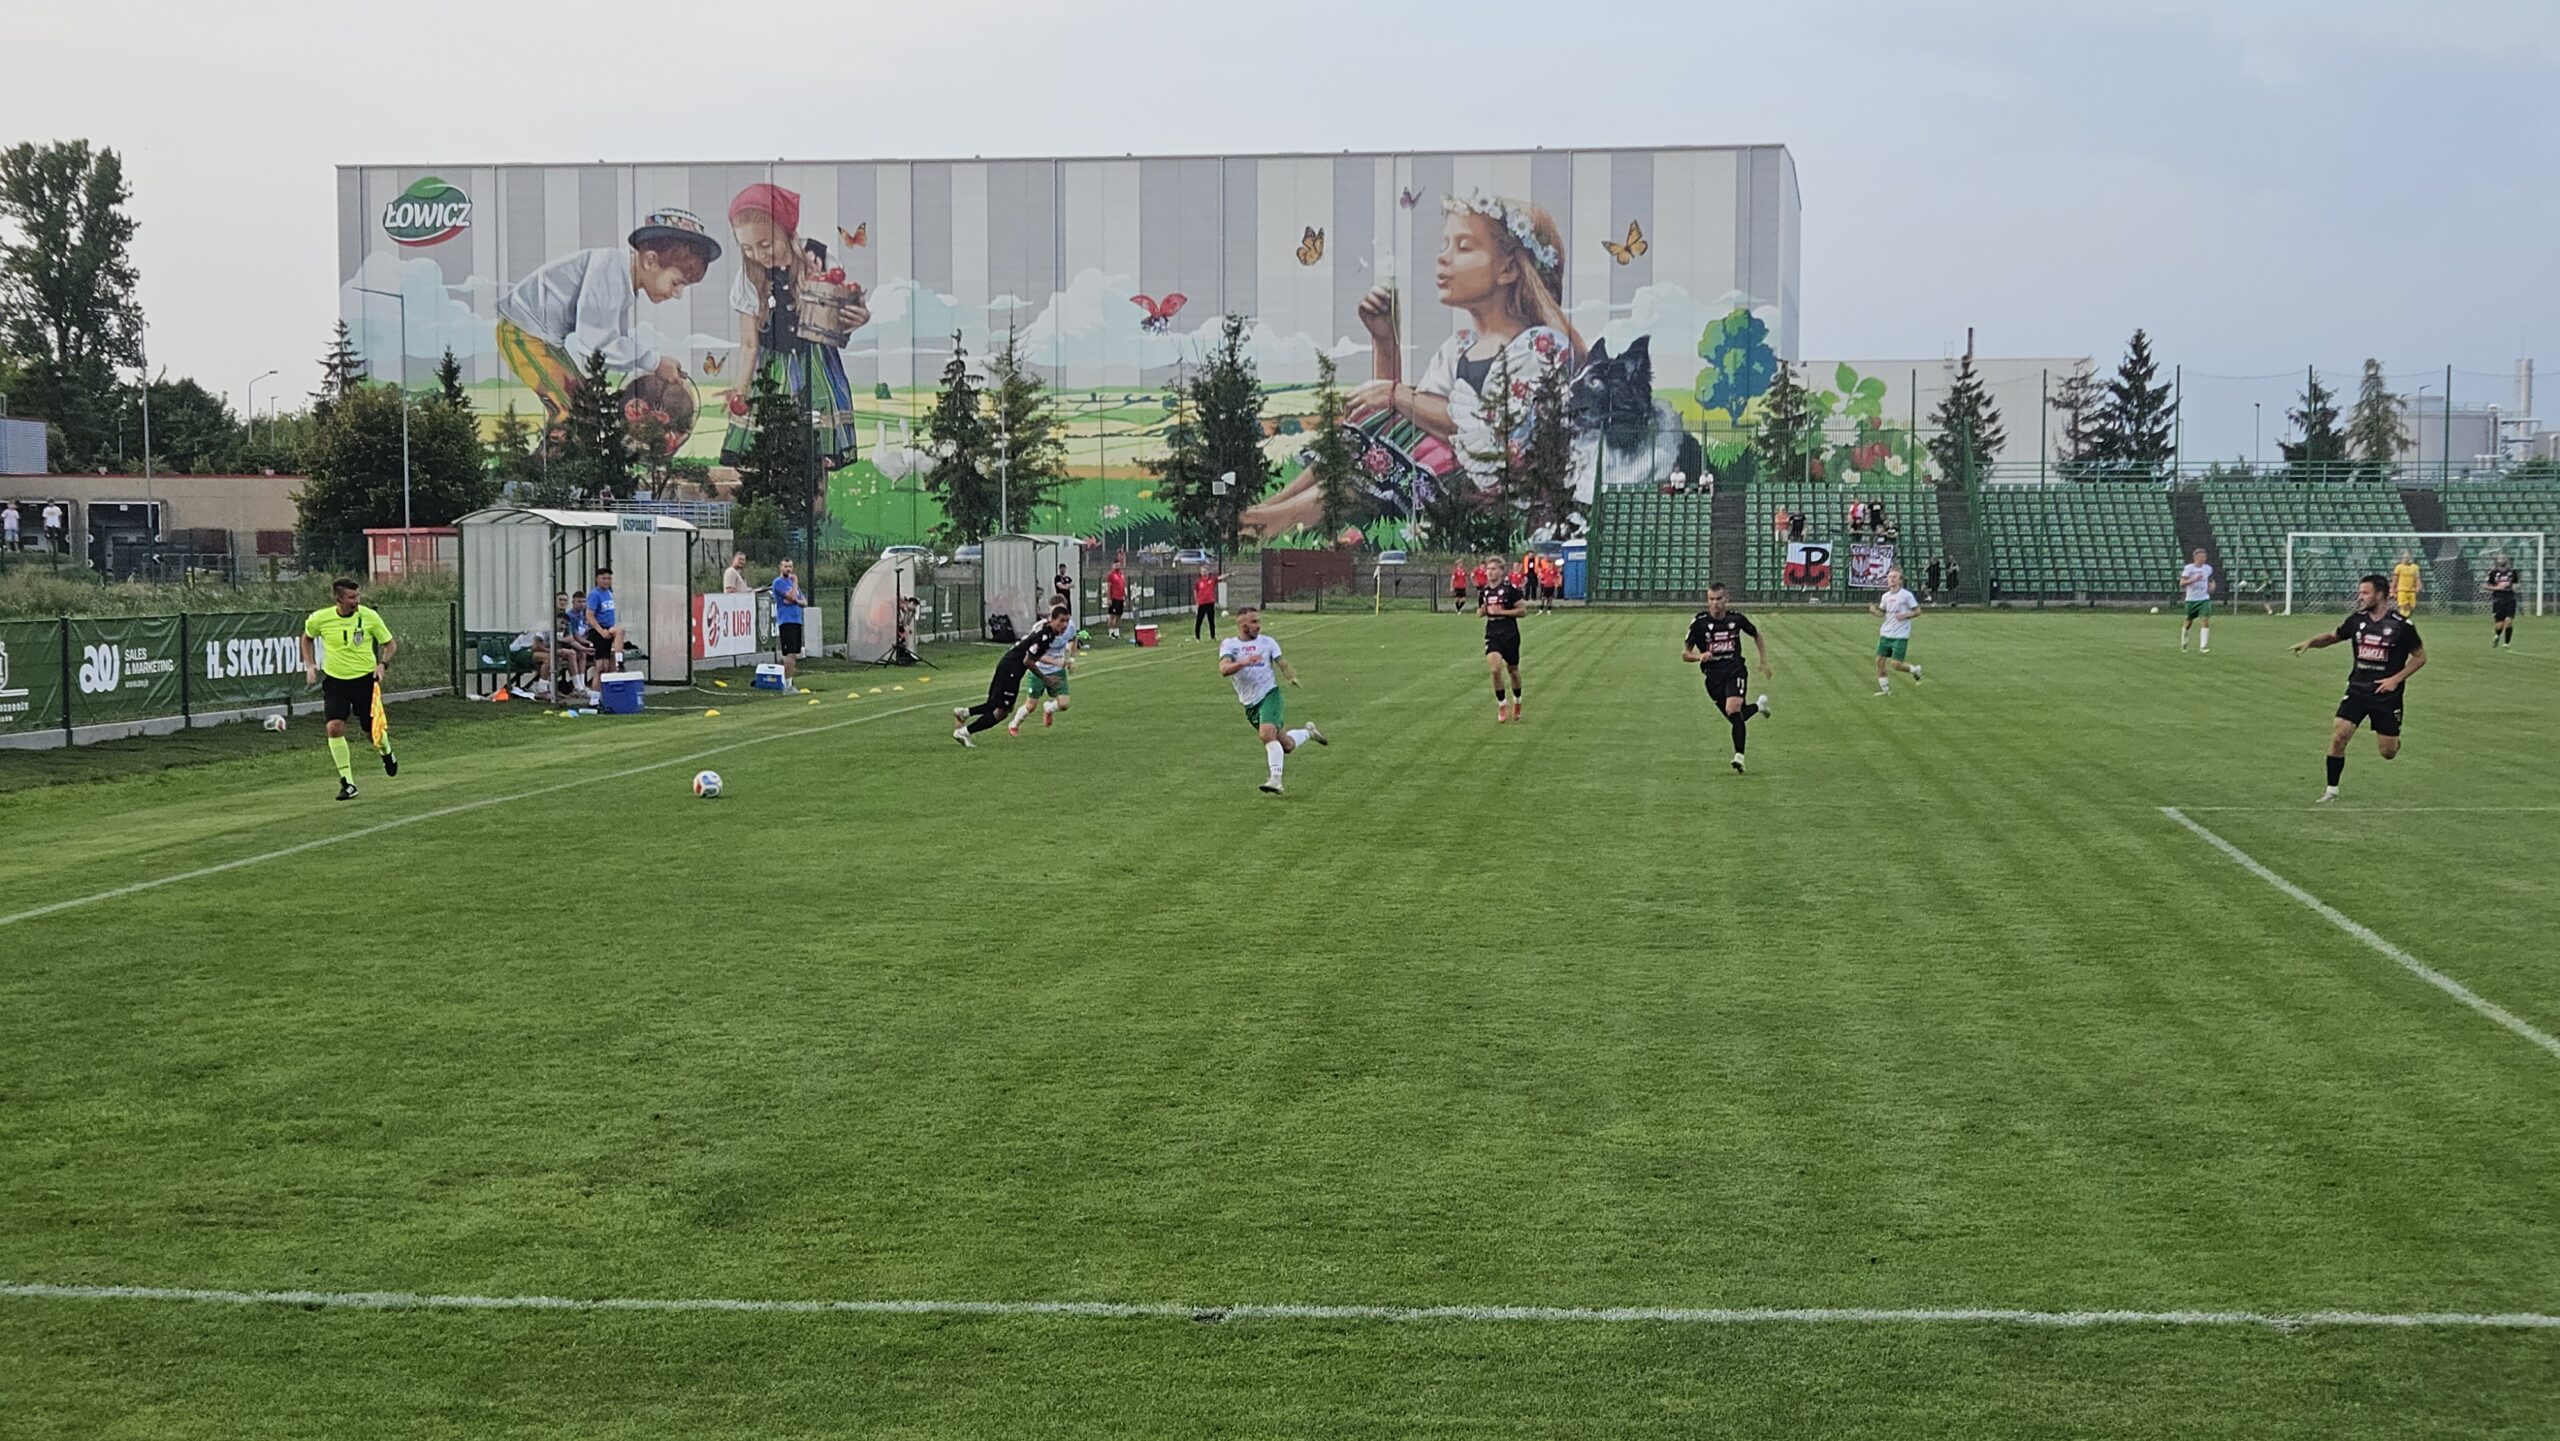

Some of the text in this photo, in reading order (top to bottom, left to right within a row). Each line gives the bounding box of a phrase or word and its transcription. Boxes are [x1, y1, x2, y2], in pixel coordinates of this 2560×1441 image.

[385, 202, 471, 228] ŁOWICZ
[723, 611, 728, 637] 3
[733, 610, 751, 637] LIGA
[124, 647, 147, 661] SALES
[125, 658, 174, 675] & MARKETING
[206, 641, 224, 679] H.
